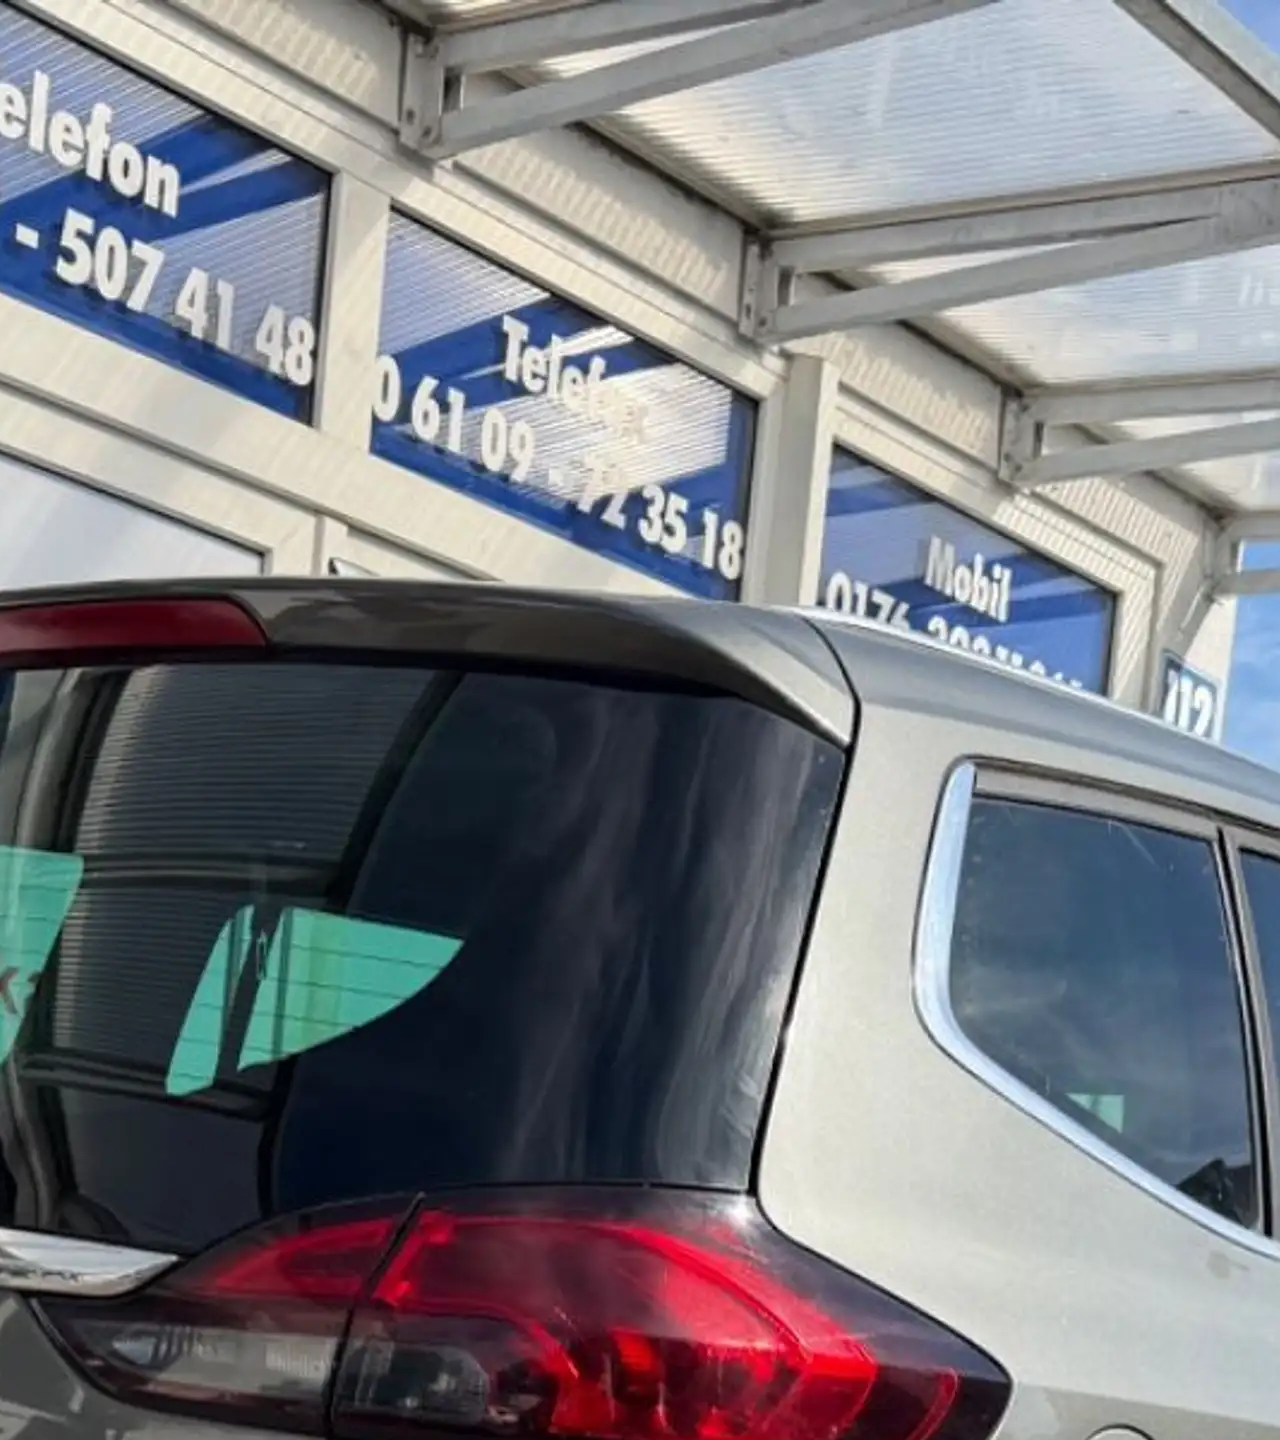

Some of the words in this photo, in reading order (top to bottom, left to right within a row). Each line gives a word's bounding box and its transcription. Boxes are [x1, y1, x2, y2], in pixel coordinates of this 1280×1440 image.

[55, 208, 164, 313] 507
[175, 268, 235, 351] 41
[256, 304, 315, 386] 48
[372, 354, 401, 422] 0
[411, 376, 466, 453] 61
[481, 408, 535, 483] 09
[638, 484, 688, 554] 35
[701, 508, 743, 580] 18
[924, 535, 1011, 623] Mobil
